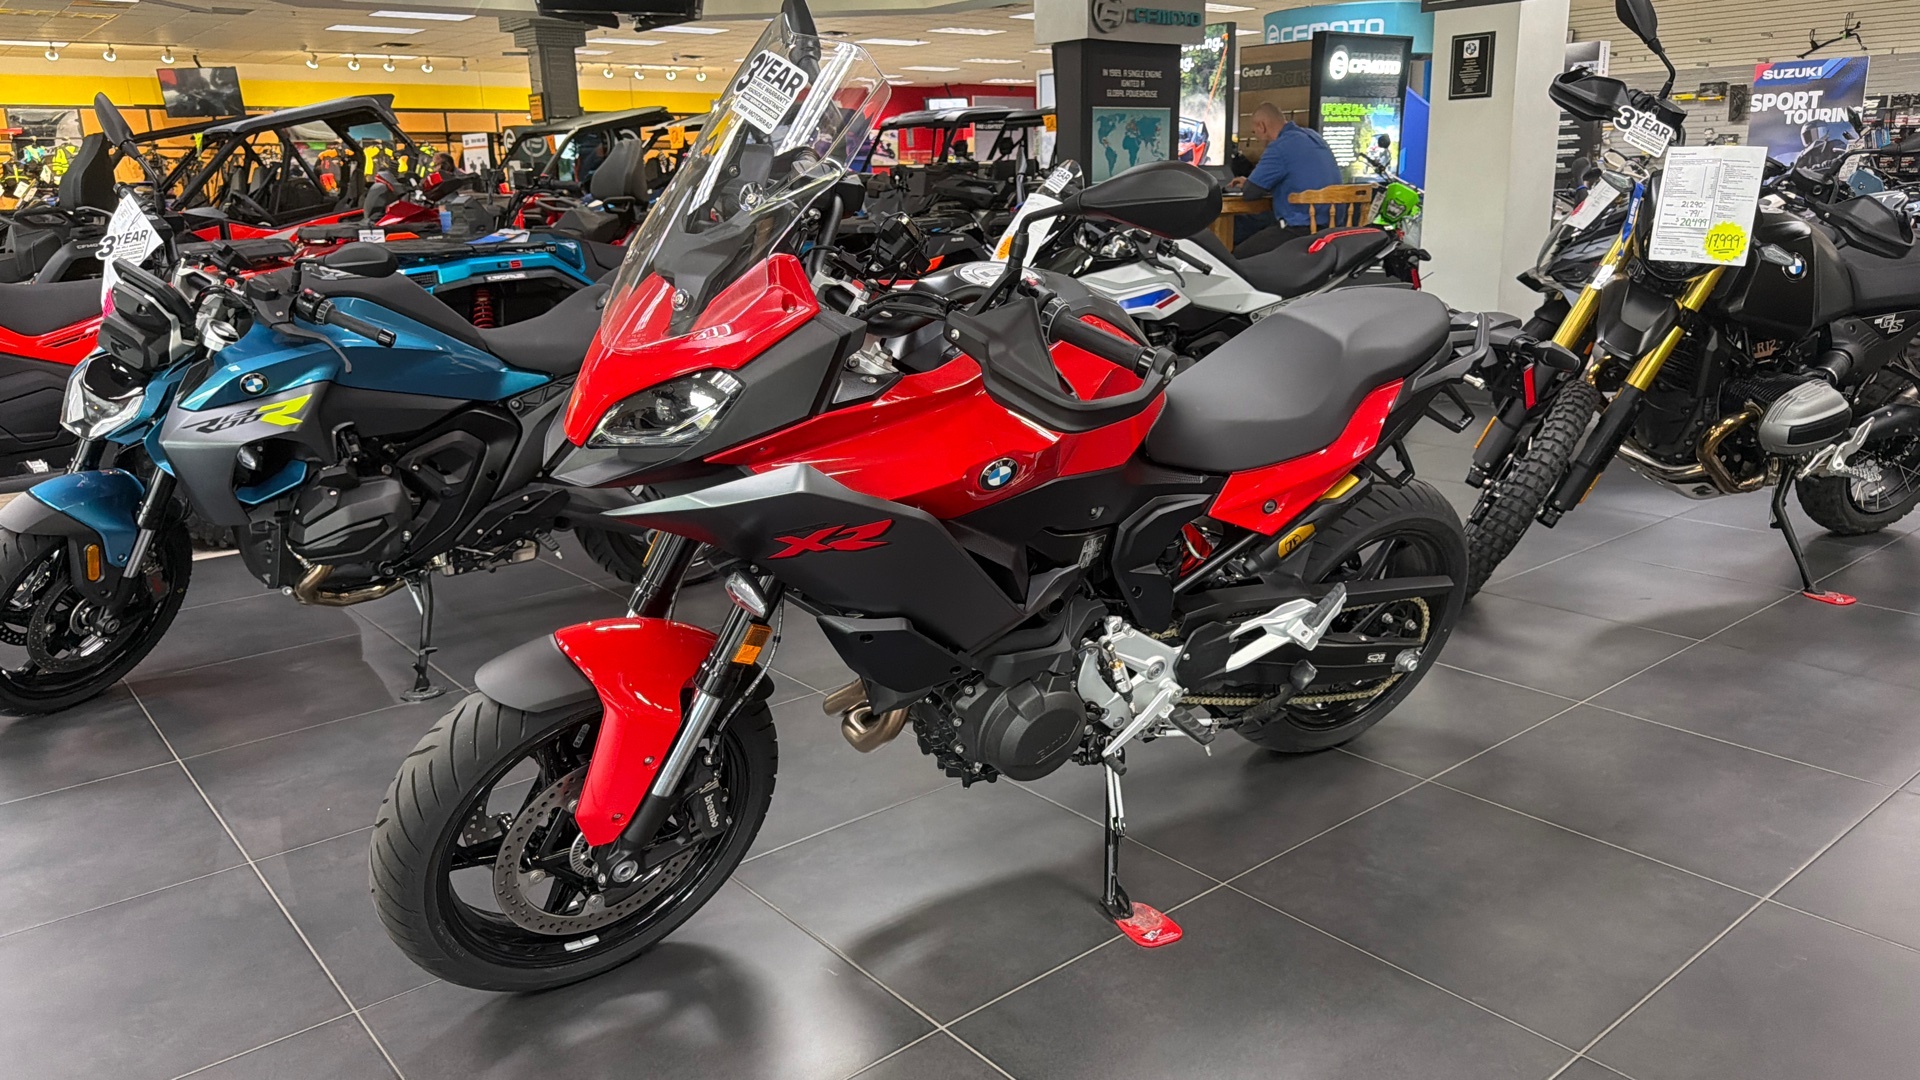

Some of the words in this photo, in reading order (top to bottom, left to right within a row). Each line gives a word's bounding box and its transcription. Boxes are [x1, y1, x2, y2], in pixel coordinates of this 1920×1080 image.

[735, 53, 766, 92] 3
[757, 55, 804, 98] YEAR
[1241, 66, 1265, 78] Gear
[1264, 64, 1273, 76] &
[1762, 66, 1823, 80] SUZUKI
[765, 86, 789, 106] WARRANTY
[1750, 90, 1824, 113] SPORT
[748, 108, 773, 130] MOTORRAD
[1615, 107, 1636, 130] 3
[1635, 112, 1671, 140] YEAR
[97, 235, 117, 258] 3
[117, 229, 149, 246] YEAR
[704, 793, 720, 828] brembo
